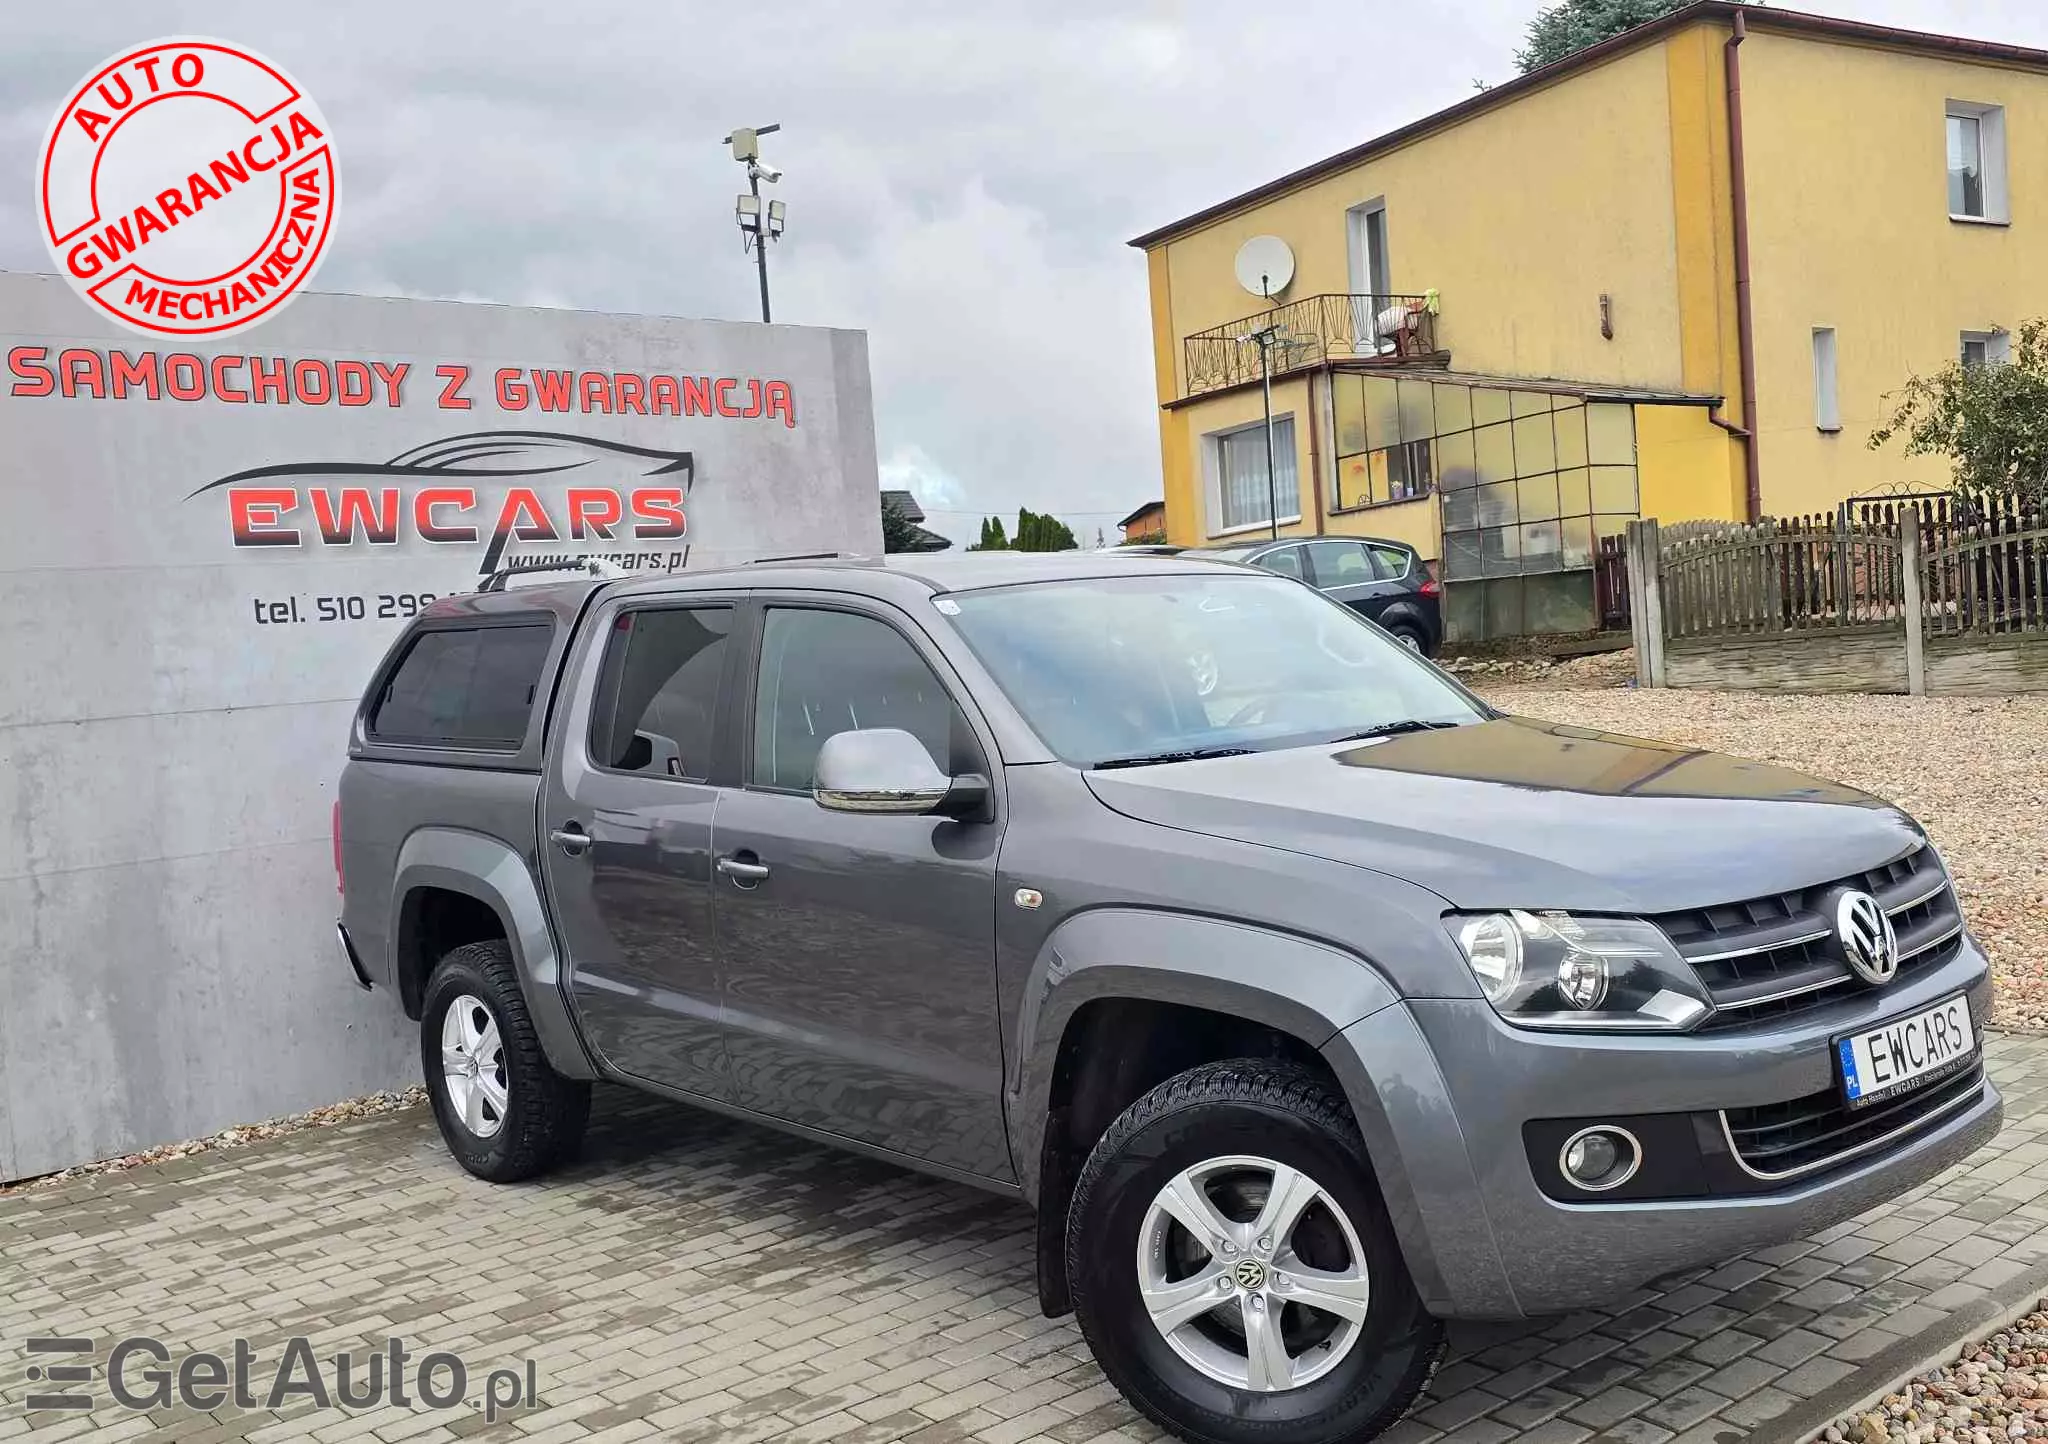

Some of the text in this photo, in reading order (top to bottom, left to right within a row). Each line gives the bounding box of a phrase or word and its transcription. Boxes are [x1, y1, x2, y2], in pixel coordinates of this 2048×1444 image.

[8, 346, 796, 428] SAMOCHODY Z GWARANCJĄ
[228, 486, 690, 576] EWCARS
[508, 544, 691, 573] wwwecars.pl
[254, 596, 306, 624] tel.
[317, 596, 365, 621] 510
[1868, 1006, 1962, 1084] EWCARS
[1846, 1074, 1859, 1090] PL
[1890, 1077, 1921, 1096] EWCARS
